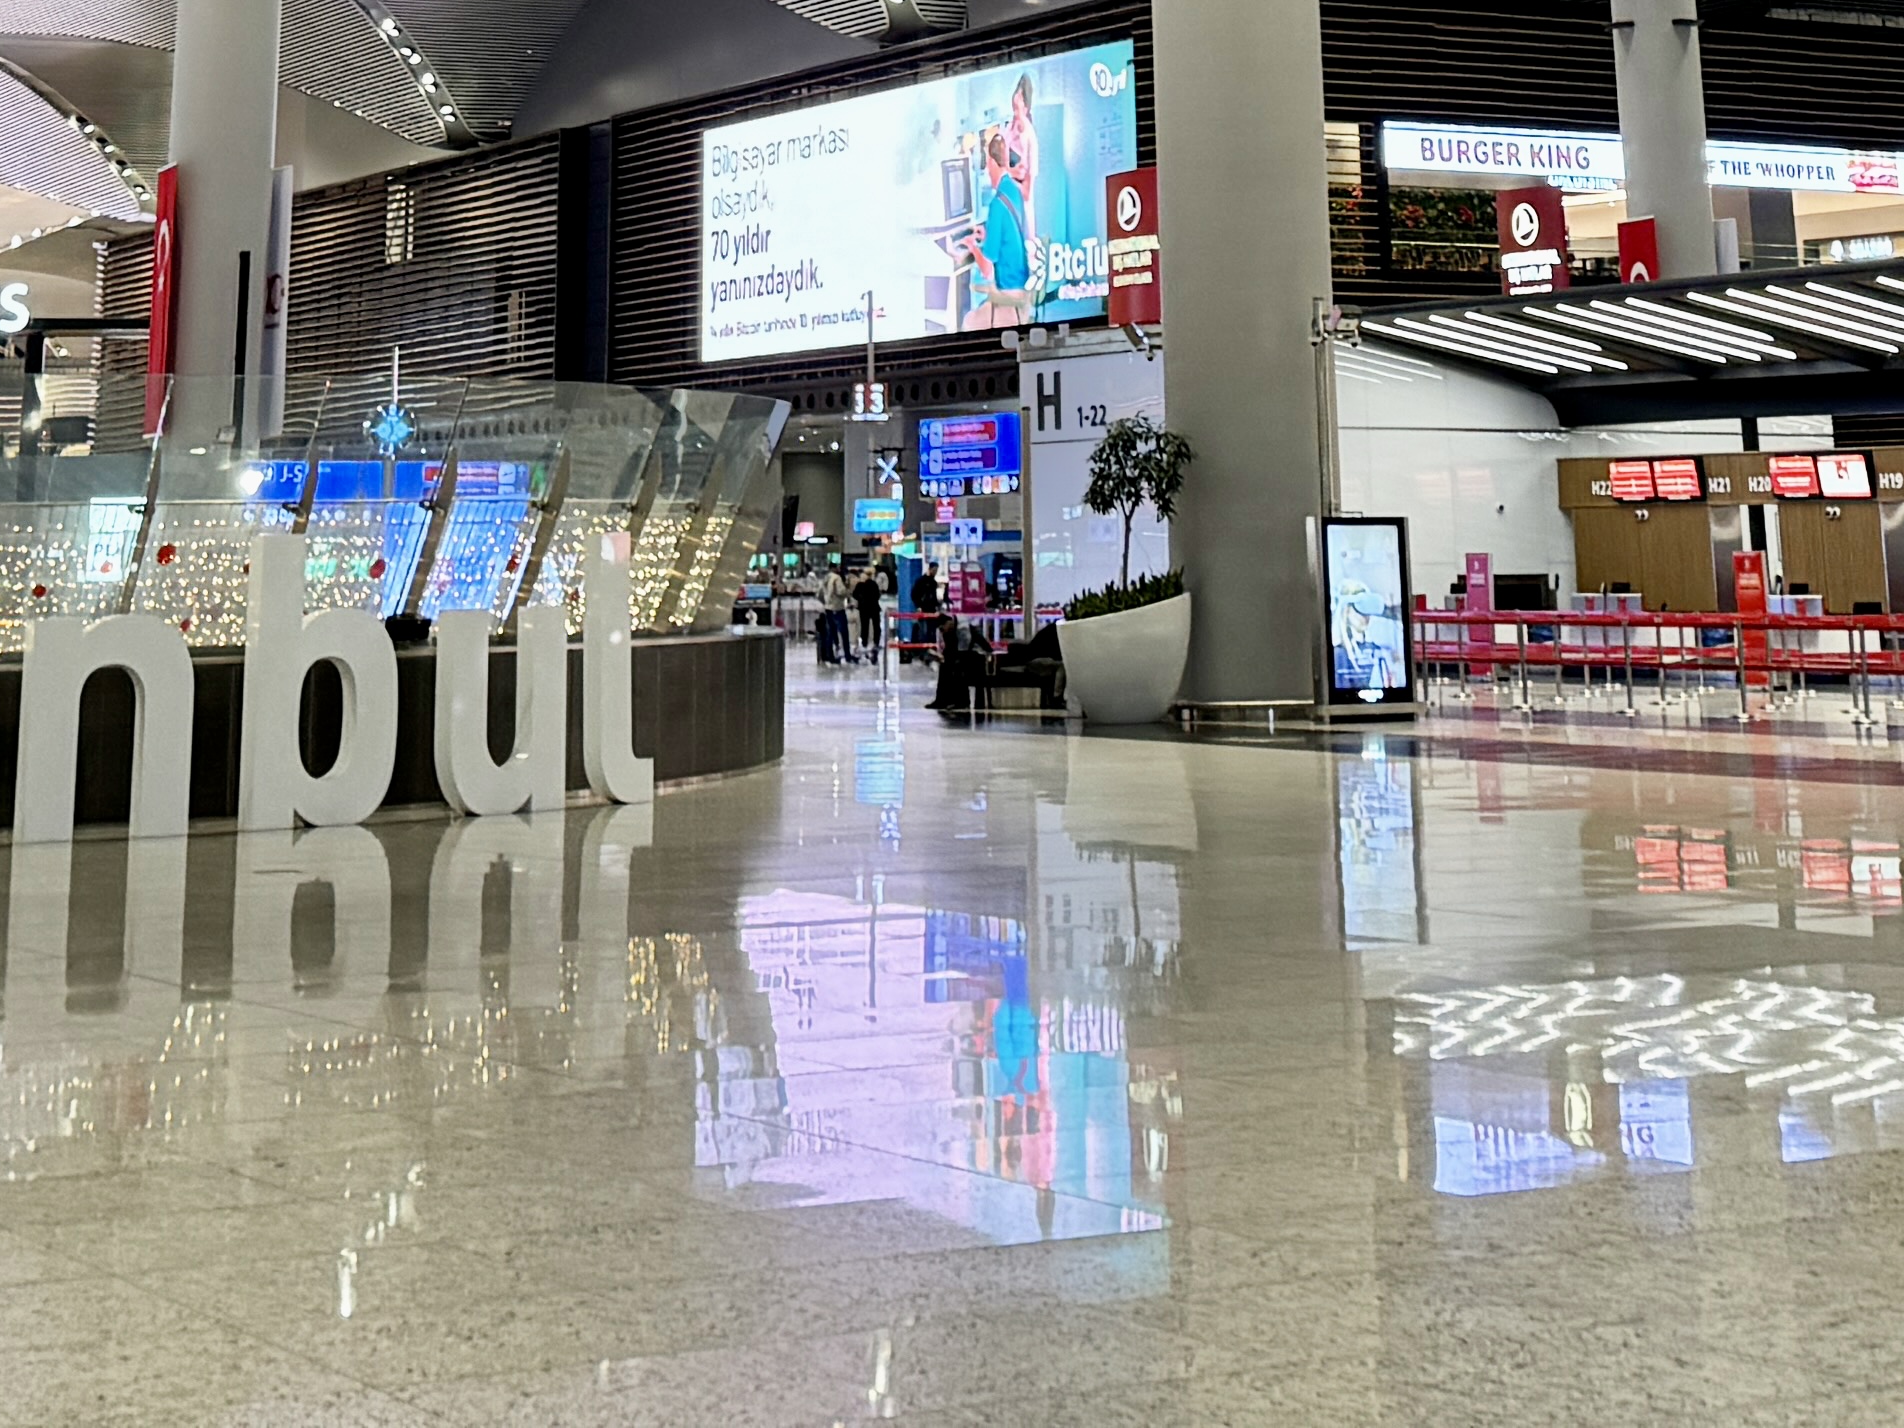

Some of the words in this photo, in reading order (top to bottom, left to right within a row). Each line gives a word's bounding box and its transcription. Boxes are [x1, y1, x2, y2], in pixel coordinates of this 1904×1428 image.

[711, 139, 783, 182] Bilgisayar
[786, 124, 850, 164] markası
[1420, 137, 1523, 168] BURGER
[1529, 143, 1591, 171] KING
[1719, 160, 1752, 176] THE
[1755, 162, 1836, 182] WHOPPER
[710, 229, 729, 262] 70
[733, 222, 772, 267] yıldır
[710, 257, 824, 314] yanınızdaydık.
[1036, 370, 1062, 432] H
[1077, 403, 1108, 429] 1-22
[1591, 479, 1613, 496] H22
[1707, 476, 1732, 494] H21
[1748, 476, 1772, 493] H20
[1878, 472, 1904, 490] H19
